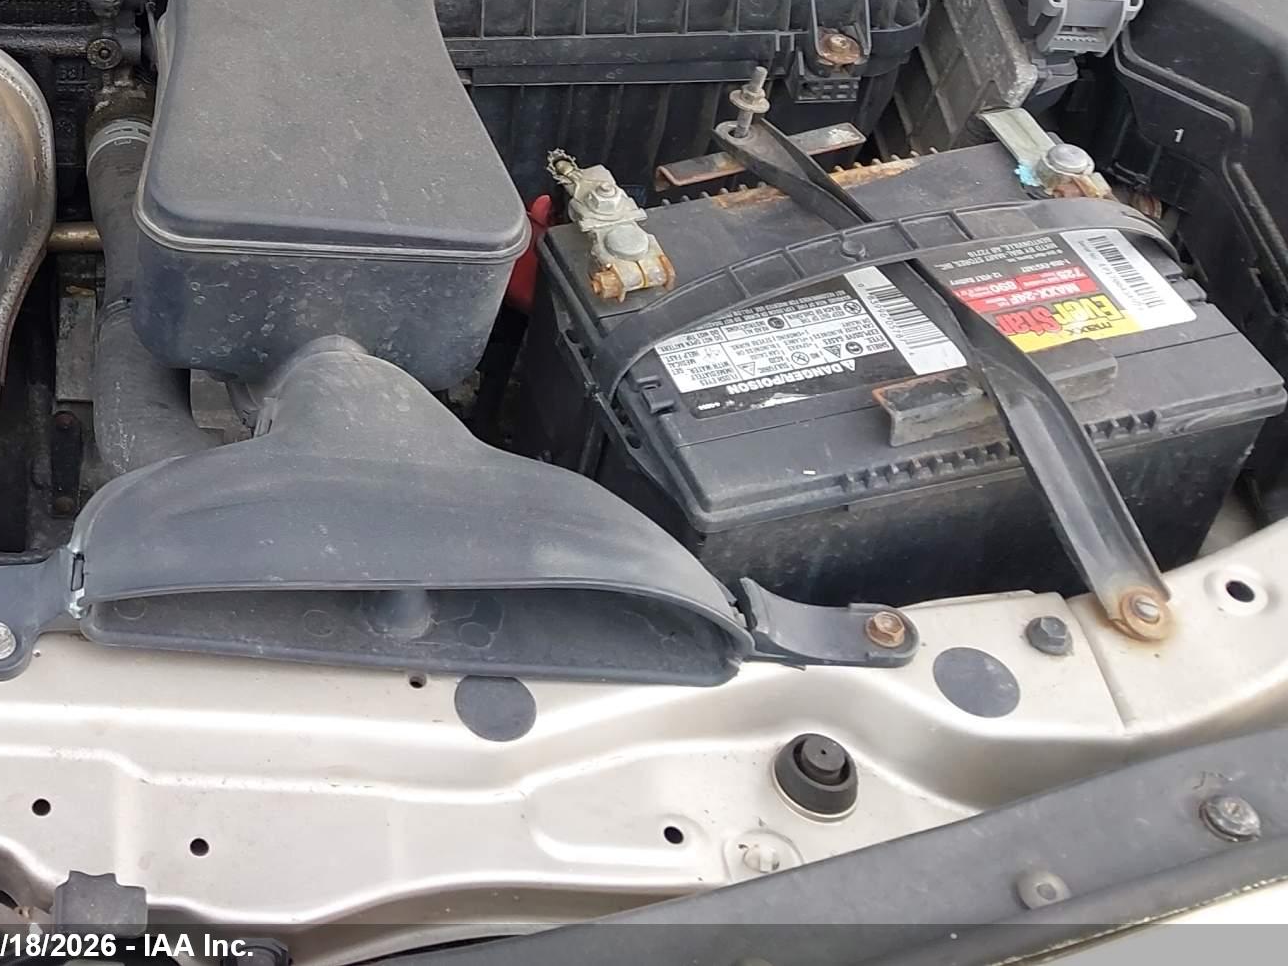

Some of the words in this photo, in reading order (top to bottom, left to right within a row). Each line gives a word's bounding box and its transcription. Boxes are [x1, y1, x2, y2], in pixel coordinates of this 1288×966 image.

[983, 248, 1025, 261] WAL-MART
[988, 280, 1017, 292] 890
[994, 294, 1126, 337] EverStar
[844, 328, 880, 339] EXPLOSIVE
[821, 336, 844, 344] GASES
[865, 342, 889, 351] SHIELD
[681, 350, 699, 358] HELP
[767, 355, 784, 363] ACID
[666, 358, 696, 368] MEDICAL
[689, 367, 734, 381] IMMEDIATELY
[715, 373, 738, 382] FLUSH
[724, 362, 844, 394] DANGER/POISON
